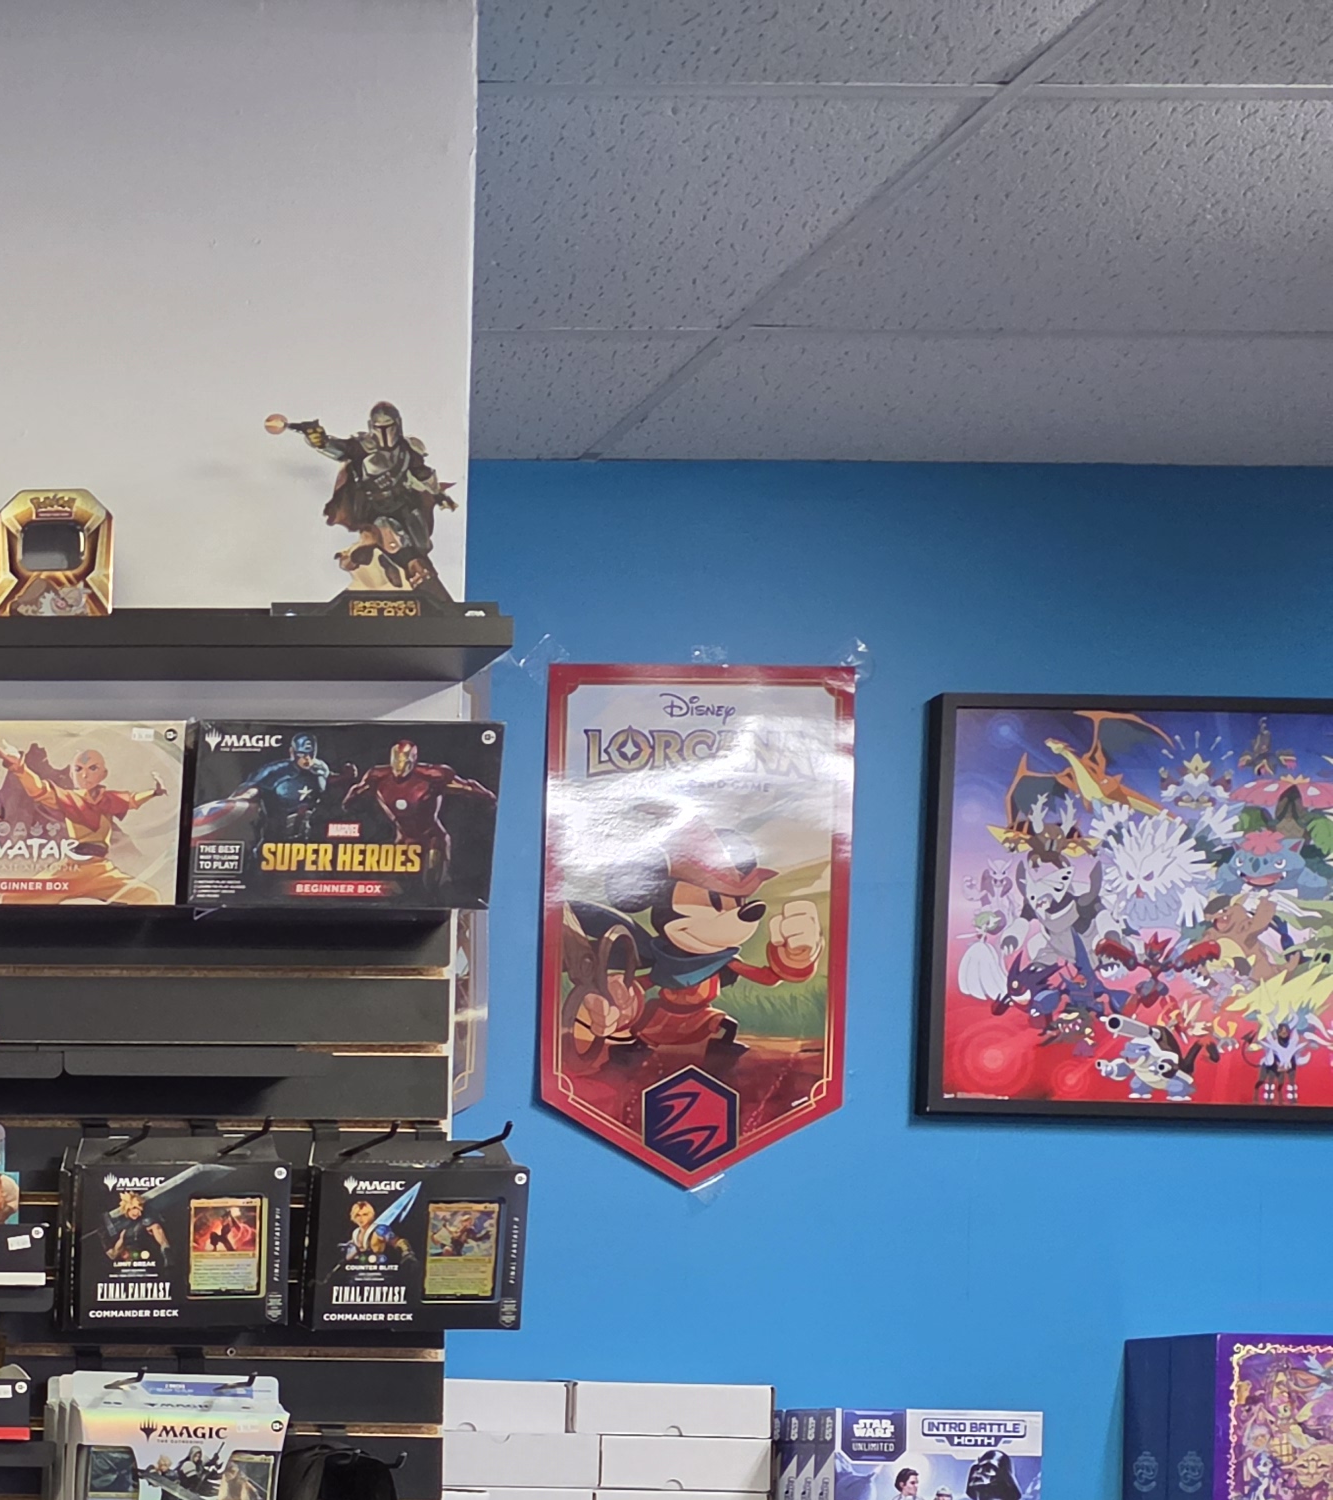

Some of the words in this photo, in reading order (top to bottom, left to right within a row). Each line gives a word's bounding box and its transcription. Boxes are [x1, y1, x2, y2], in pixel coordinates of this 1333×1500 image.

[220, 735, 282, 747] MAGIC
[200, 845, 215, 853] THE
[218, 845, 240, 853] BEST
[261, 843, 333, 871] SUPER
[336, 844, 422, 872] HEROES
[200, 861, 211, 869] TO
[213, 861, 238, 870] PLAY!
[46, 882, 69, 890] BOX
[296, 884, 355, 894] BEGINNER
[358, 884, 381, 894] BOX
[323, 1313, 385, 1321] COMMANDER
[387, 1313, 413, 1321] DECK
[859, 1419, 890, 1429] STAR
[927, 1422, 967, 1433] INTRO
[970, 1422, 1020, 1433] BATTLE
[853, 1426, 895, 1438] WARS
[954, 1437, 995, 1446] HOTH
[852, 1442, 895, 1452] UNLIMITED
